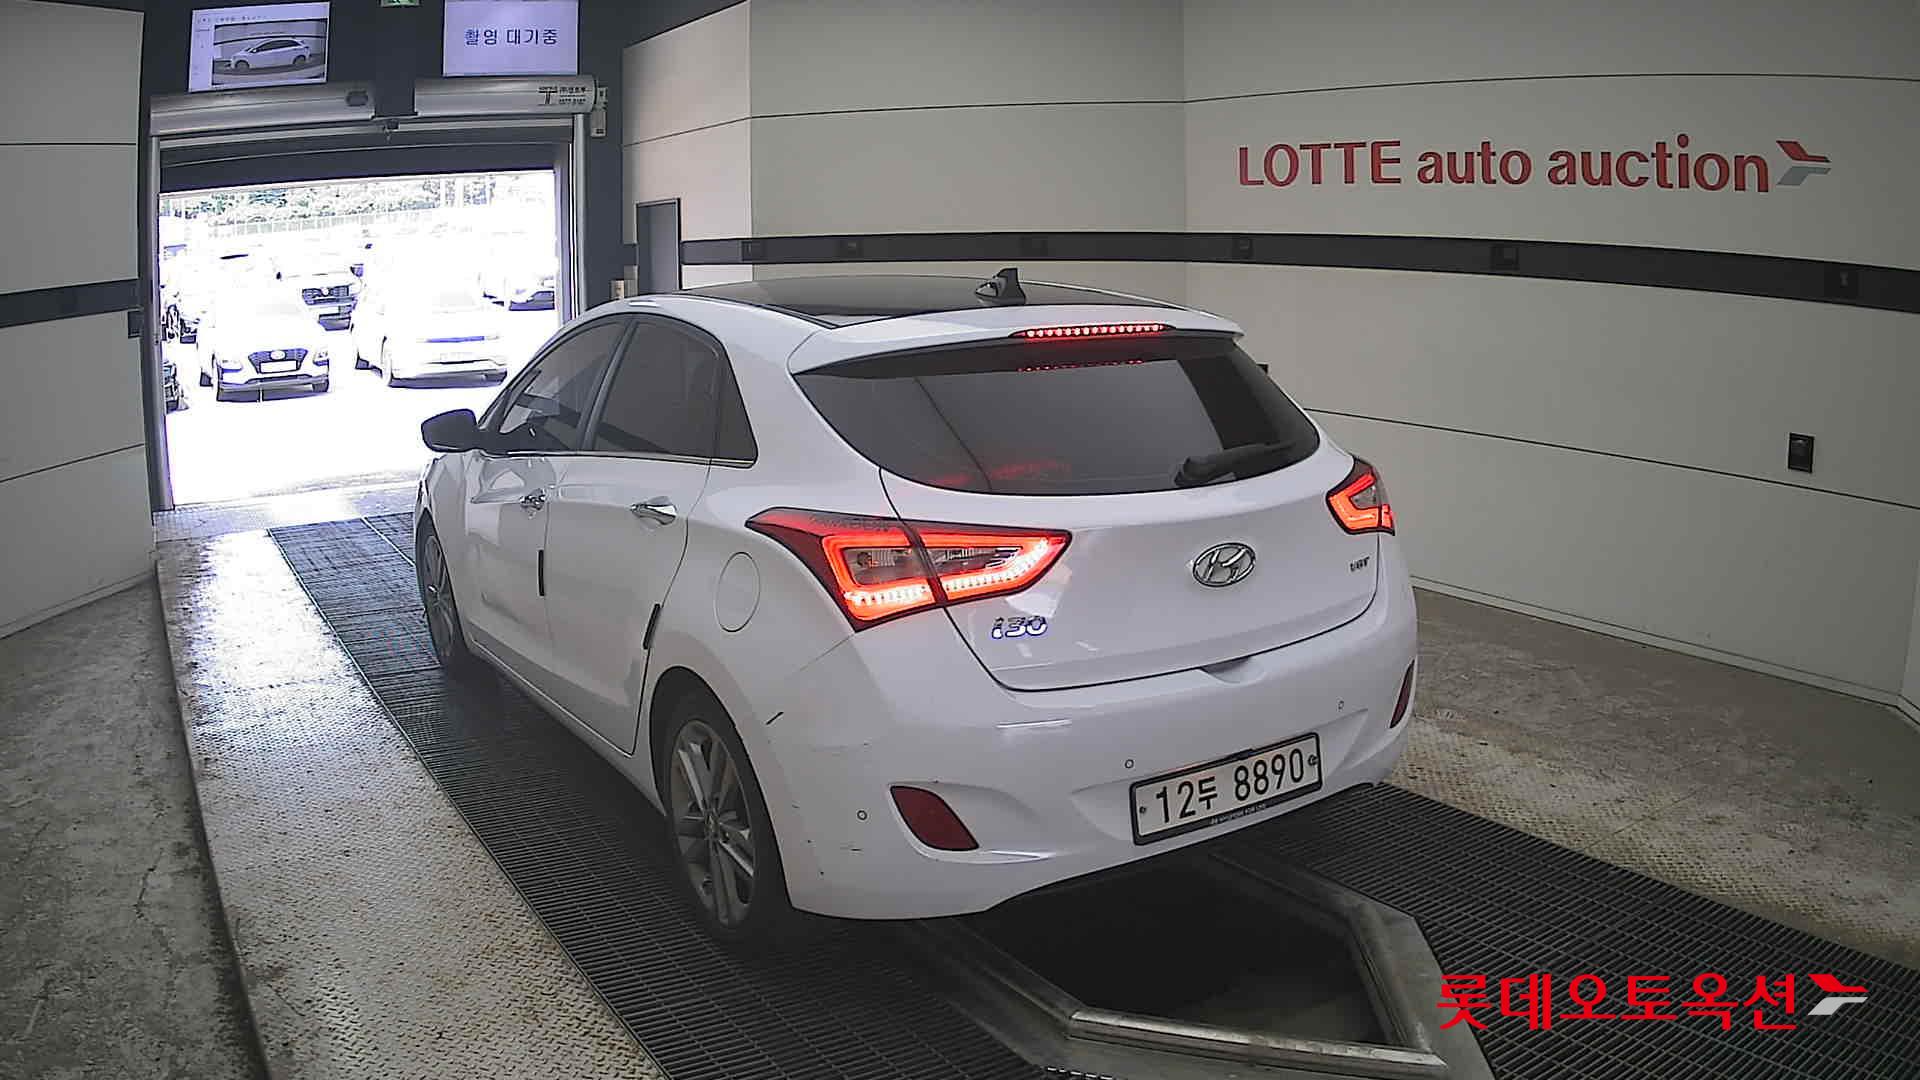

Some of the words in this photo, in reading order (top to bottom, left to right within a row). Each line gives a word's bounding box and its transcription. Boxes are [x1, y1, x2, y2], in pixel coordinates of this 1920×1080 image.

[506, 28, 558, 46] 대기중
[1240, 140, 1400, 187] LOTTE
[1417, 141, 1532, 185] auto
[1548, 134, 1770, 192] auction
[991, 615, 1048, 640] i30
[1155, 775, 1218, 824] 12두
[1233, 748, 1305, 802] 8890
